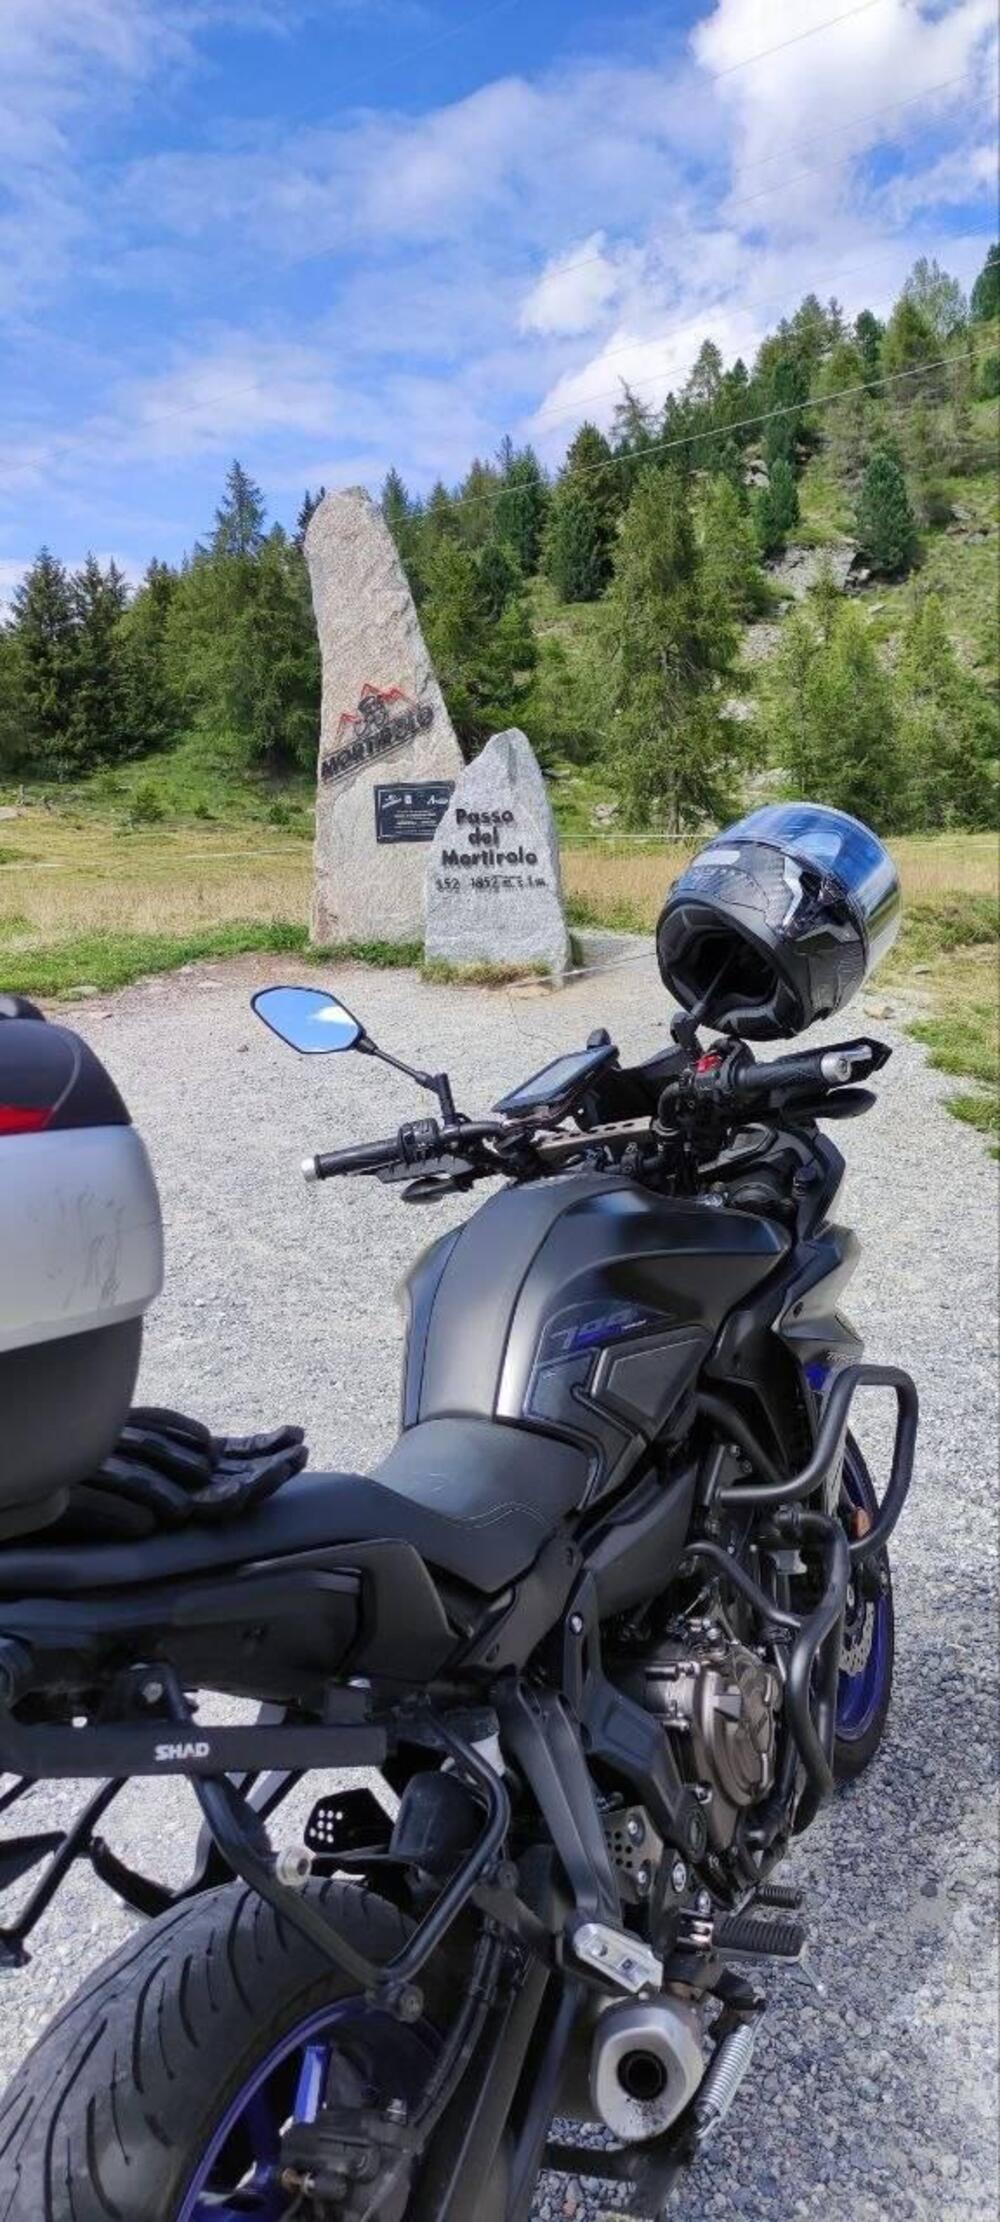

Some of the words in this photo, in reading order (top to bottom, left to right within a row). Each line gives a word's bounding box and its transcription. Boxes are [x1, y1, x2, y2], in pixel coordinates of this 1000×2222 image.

[455, 808, 514, 825] Passo
[468, 826, 500, 846] del
[441, 846, 538, 866] Mortirolo
[154, 1741, 211, 1761] SHAD
